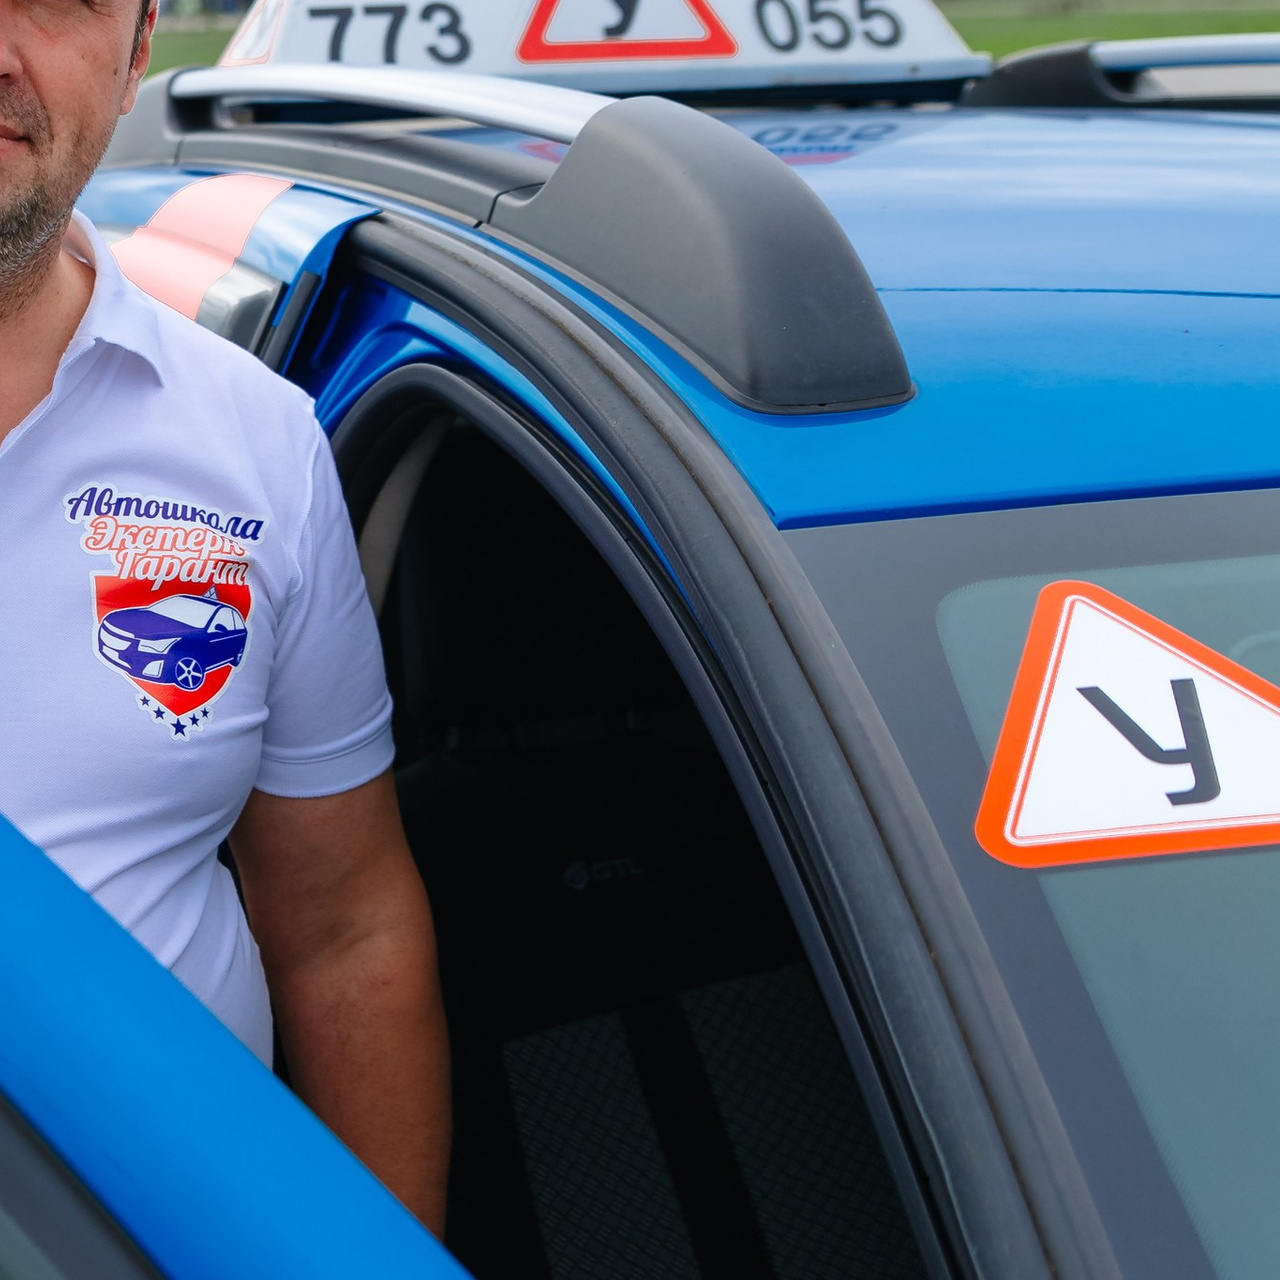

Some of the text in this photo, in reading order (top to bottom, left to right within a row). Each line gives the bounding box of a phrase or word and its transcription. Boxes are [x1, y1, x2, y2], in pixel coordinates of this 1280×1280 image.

[308, 3, 472, 66] 773
[68, 487, 264, 541] Автошкола
[115, 549, 249, 591] Гарант
